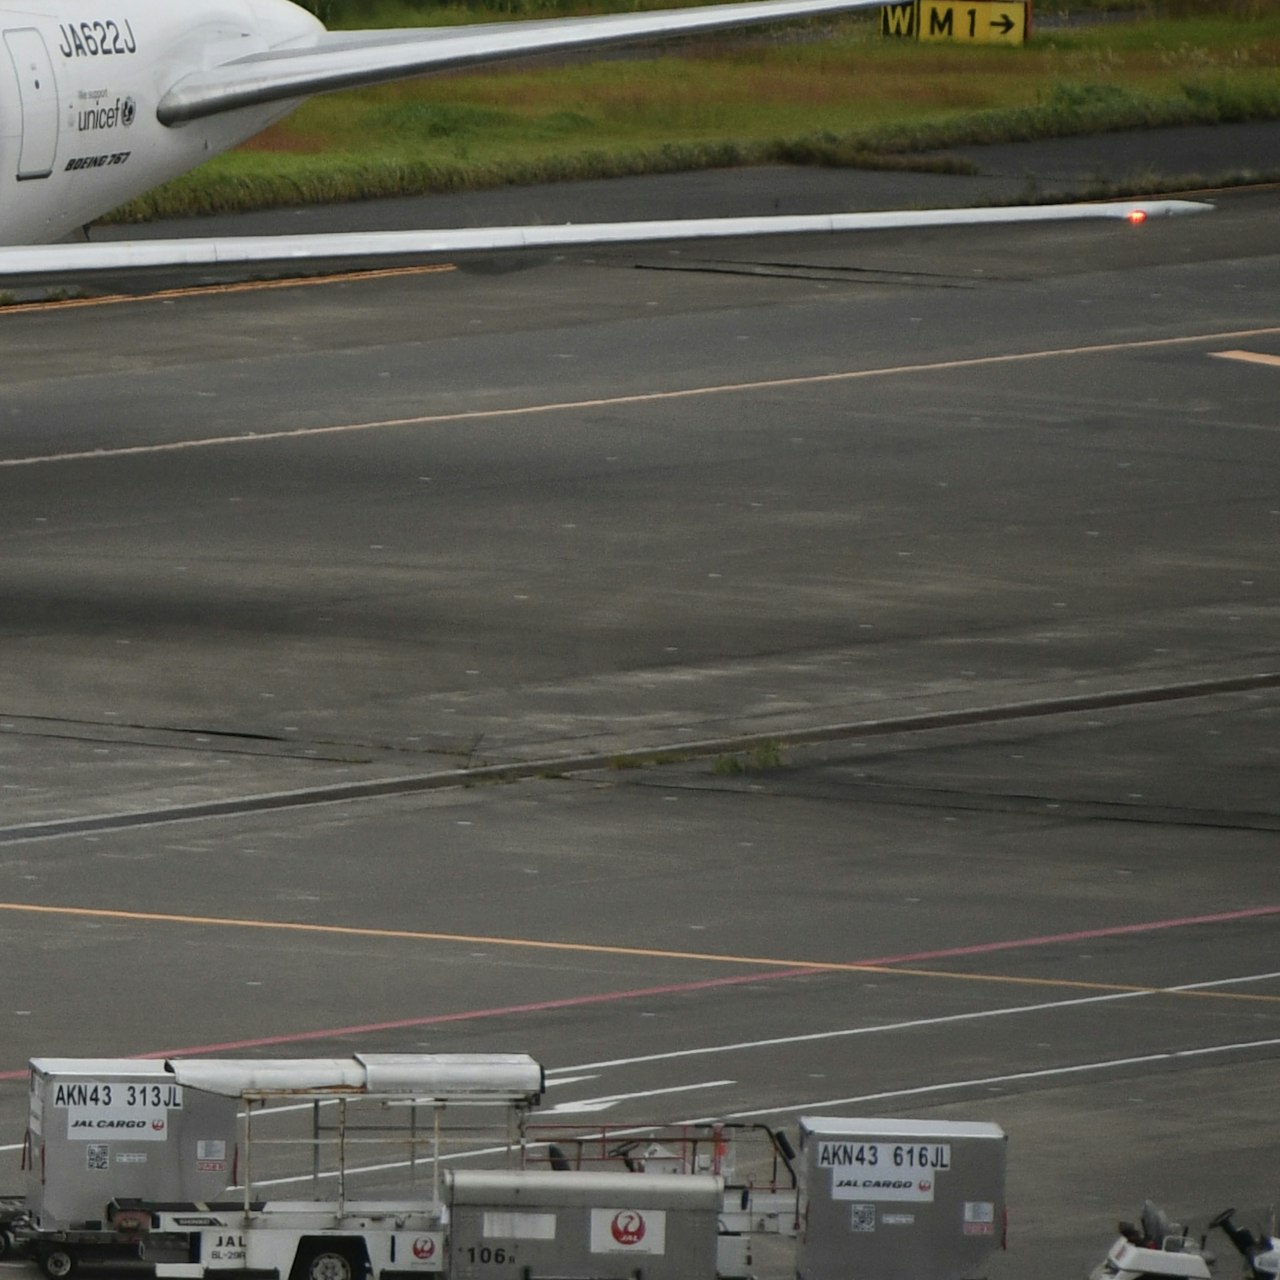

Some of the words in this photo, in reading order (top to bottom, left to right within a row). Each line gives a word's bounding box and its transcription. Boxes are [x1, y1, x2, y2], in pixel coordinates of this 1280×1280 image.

[930, 7, 976, 37] M1
[59, 19, 136, 58] JA622J
[78, 97, 120, 132] unicef
[64, 155, 108, 172] BOEING
[55, 1084, 112, 1107] AKN43
[127, 1086, 181, 1107] 313JL
[71, 1120, 95, 1128] JAL
[97, 1120, 146, 1128] CARGO
[821, 1144, 878, 1166] AKN43
[893, 1146, 948, 1168] 616JL
[836, 1180, 860, 1188] JAL
[862, 1180, 912, 1189] CARGO
[216, 1236, 247, 1247] JAL
